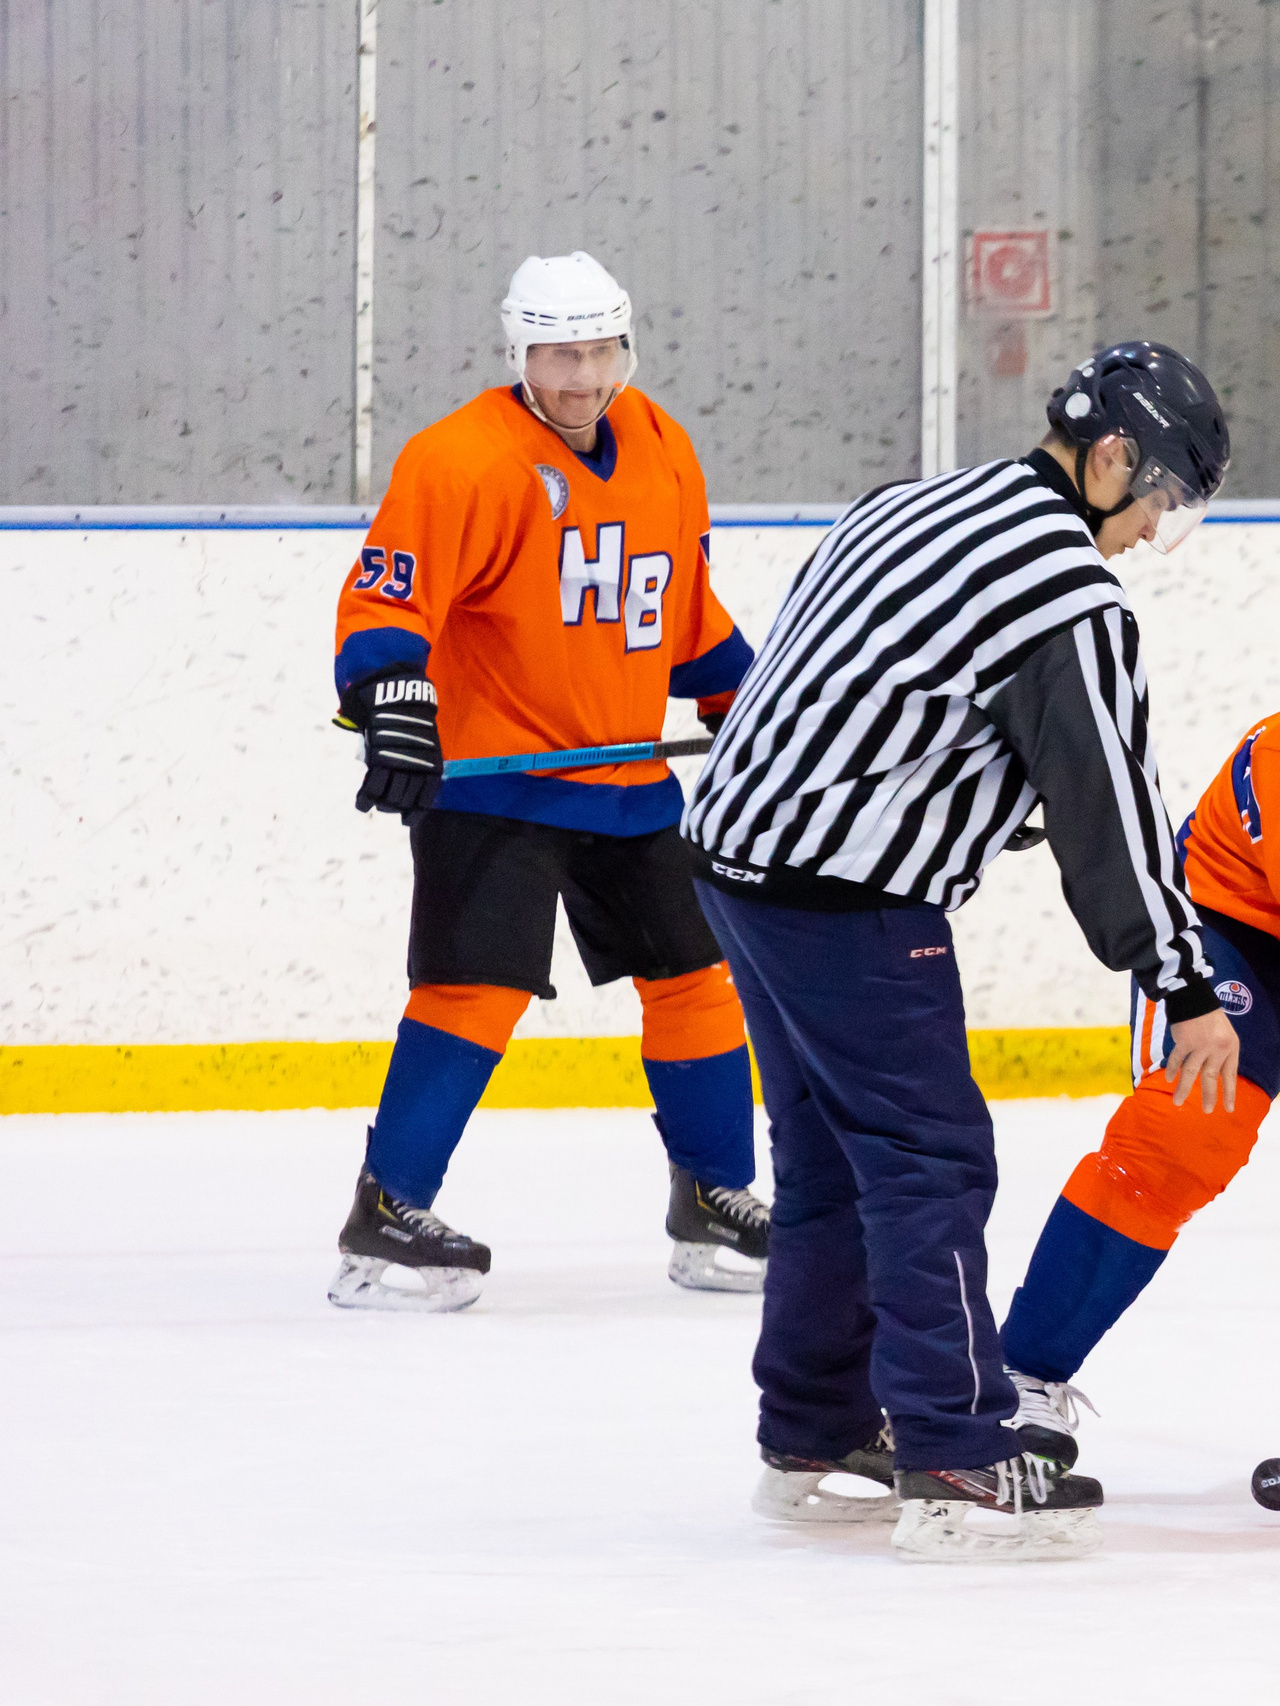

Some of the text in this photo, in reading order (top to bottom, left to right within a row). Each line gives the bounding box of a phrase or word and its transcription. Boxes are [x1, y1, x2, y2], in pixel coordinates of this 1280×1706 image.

[567, 312, 605, 321] BAUER
[1132, 391, 1171, 430] BAUER
[351, 545, 417, 601] 59
[711, 860, 767, 884] CCM
[909, 946, 947, 958] CCM
[1219, 991, 1248, 1006] OILERS
